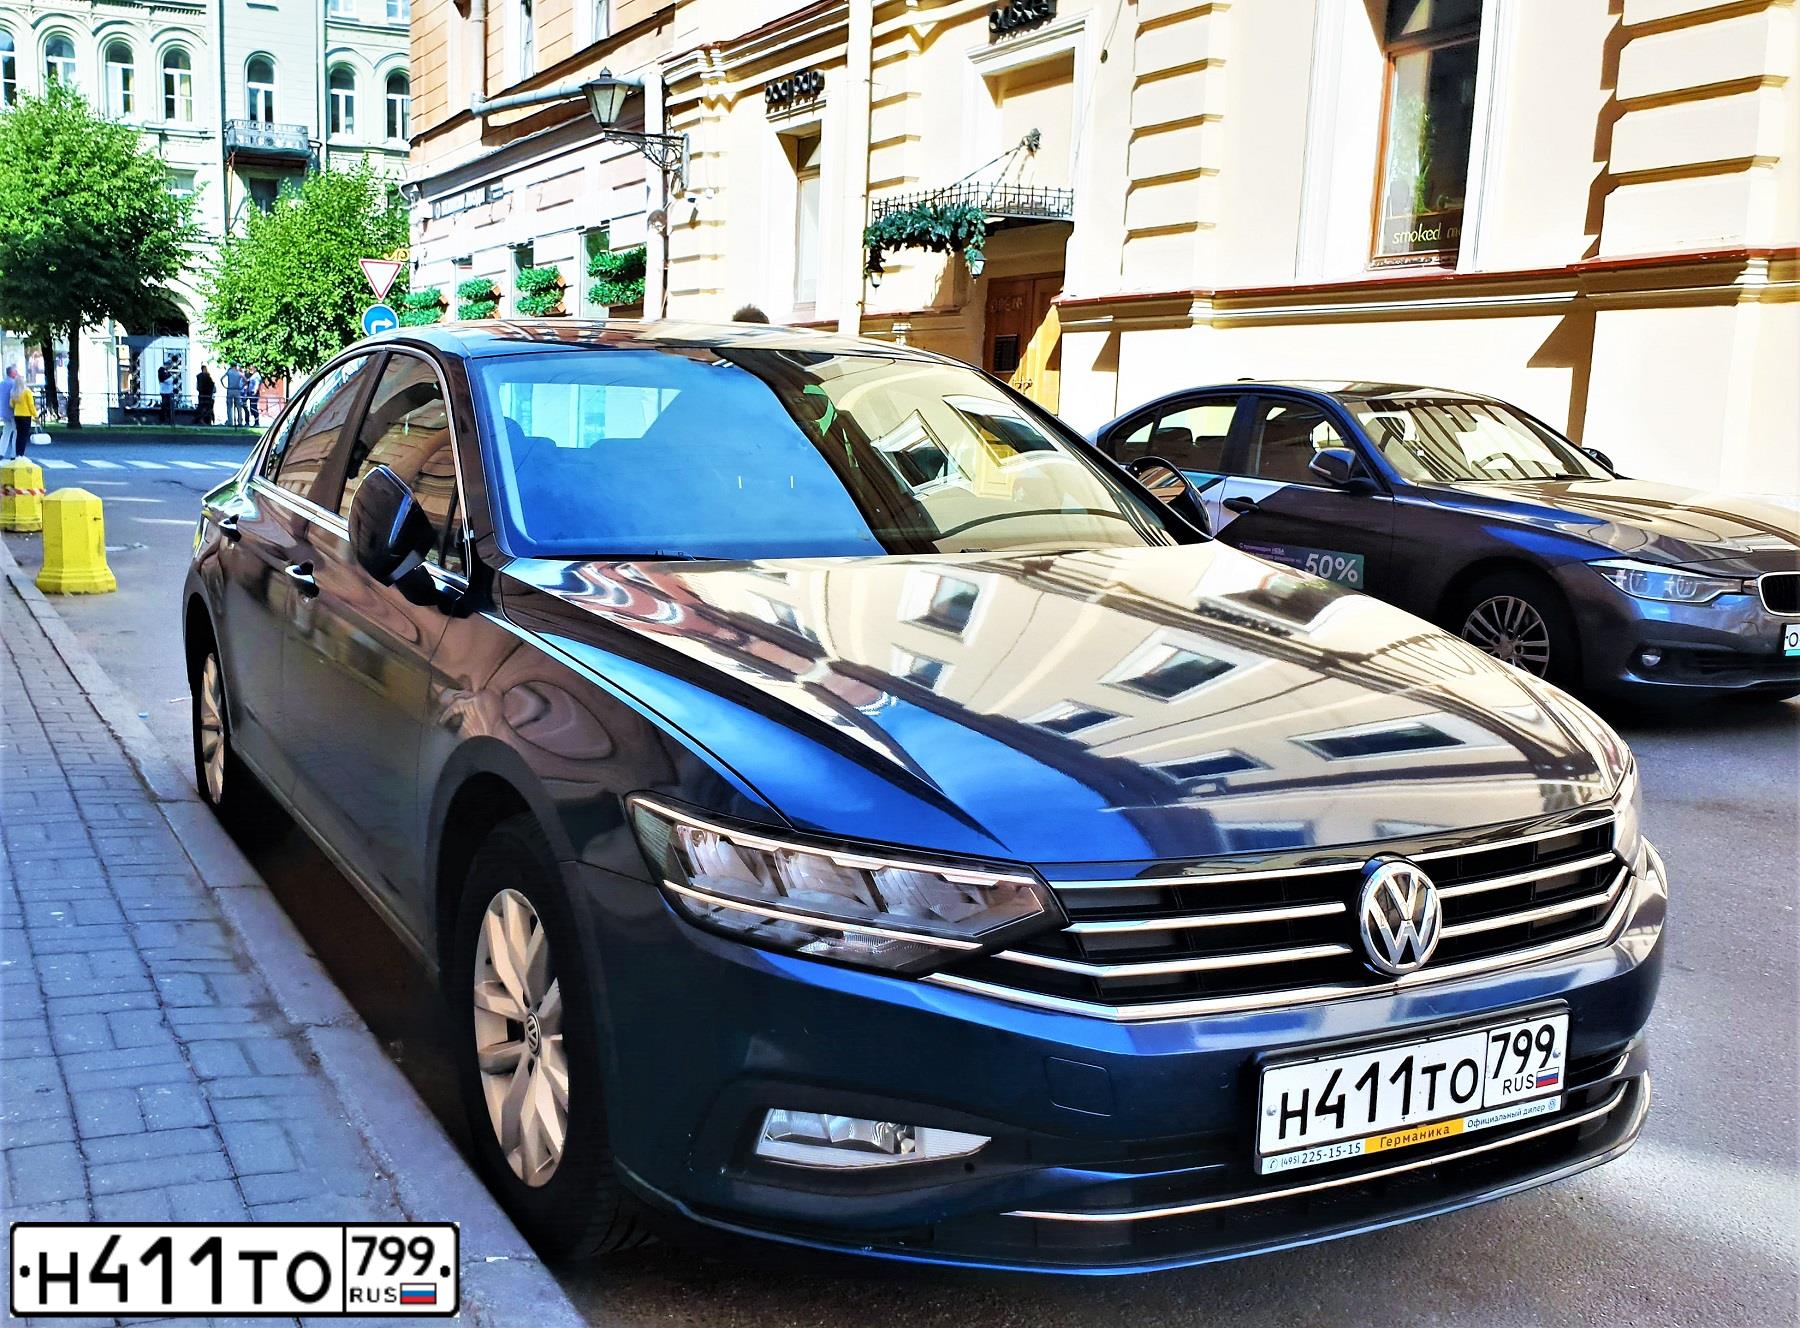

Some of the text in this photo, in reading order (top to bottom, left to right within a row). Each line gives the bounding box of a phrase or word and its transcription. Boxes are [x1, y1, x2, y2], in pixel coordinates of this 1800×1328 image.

[1392, 222, 1461, 244] smoked m
[1305, 553, 1358, 583] 50%
[1279, 1024, 1556, 1139] Н411ТО 799
[1502, 1074, 1534, 1095] RUS
[1302, 1143, 1361, 1164] 225-15-15
[1380, 1126, 1450, 1148] Германика
[1467, 1110, 1522, 1128] Официальный
